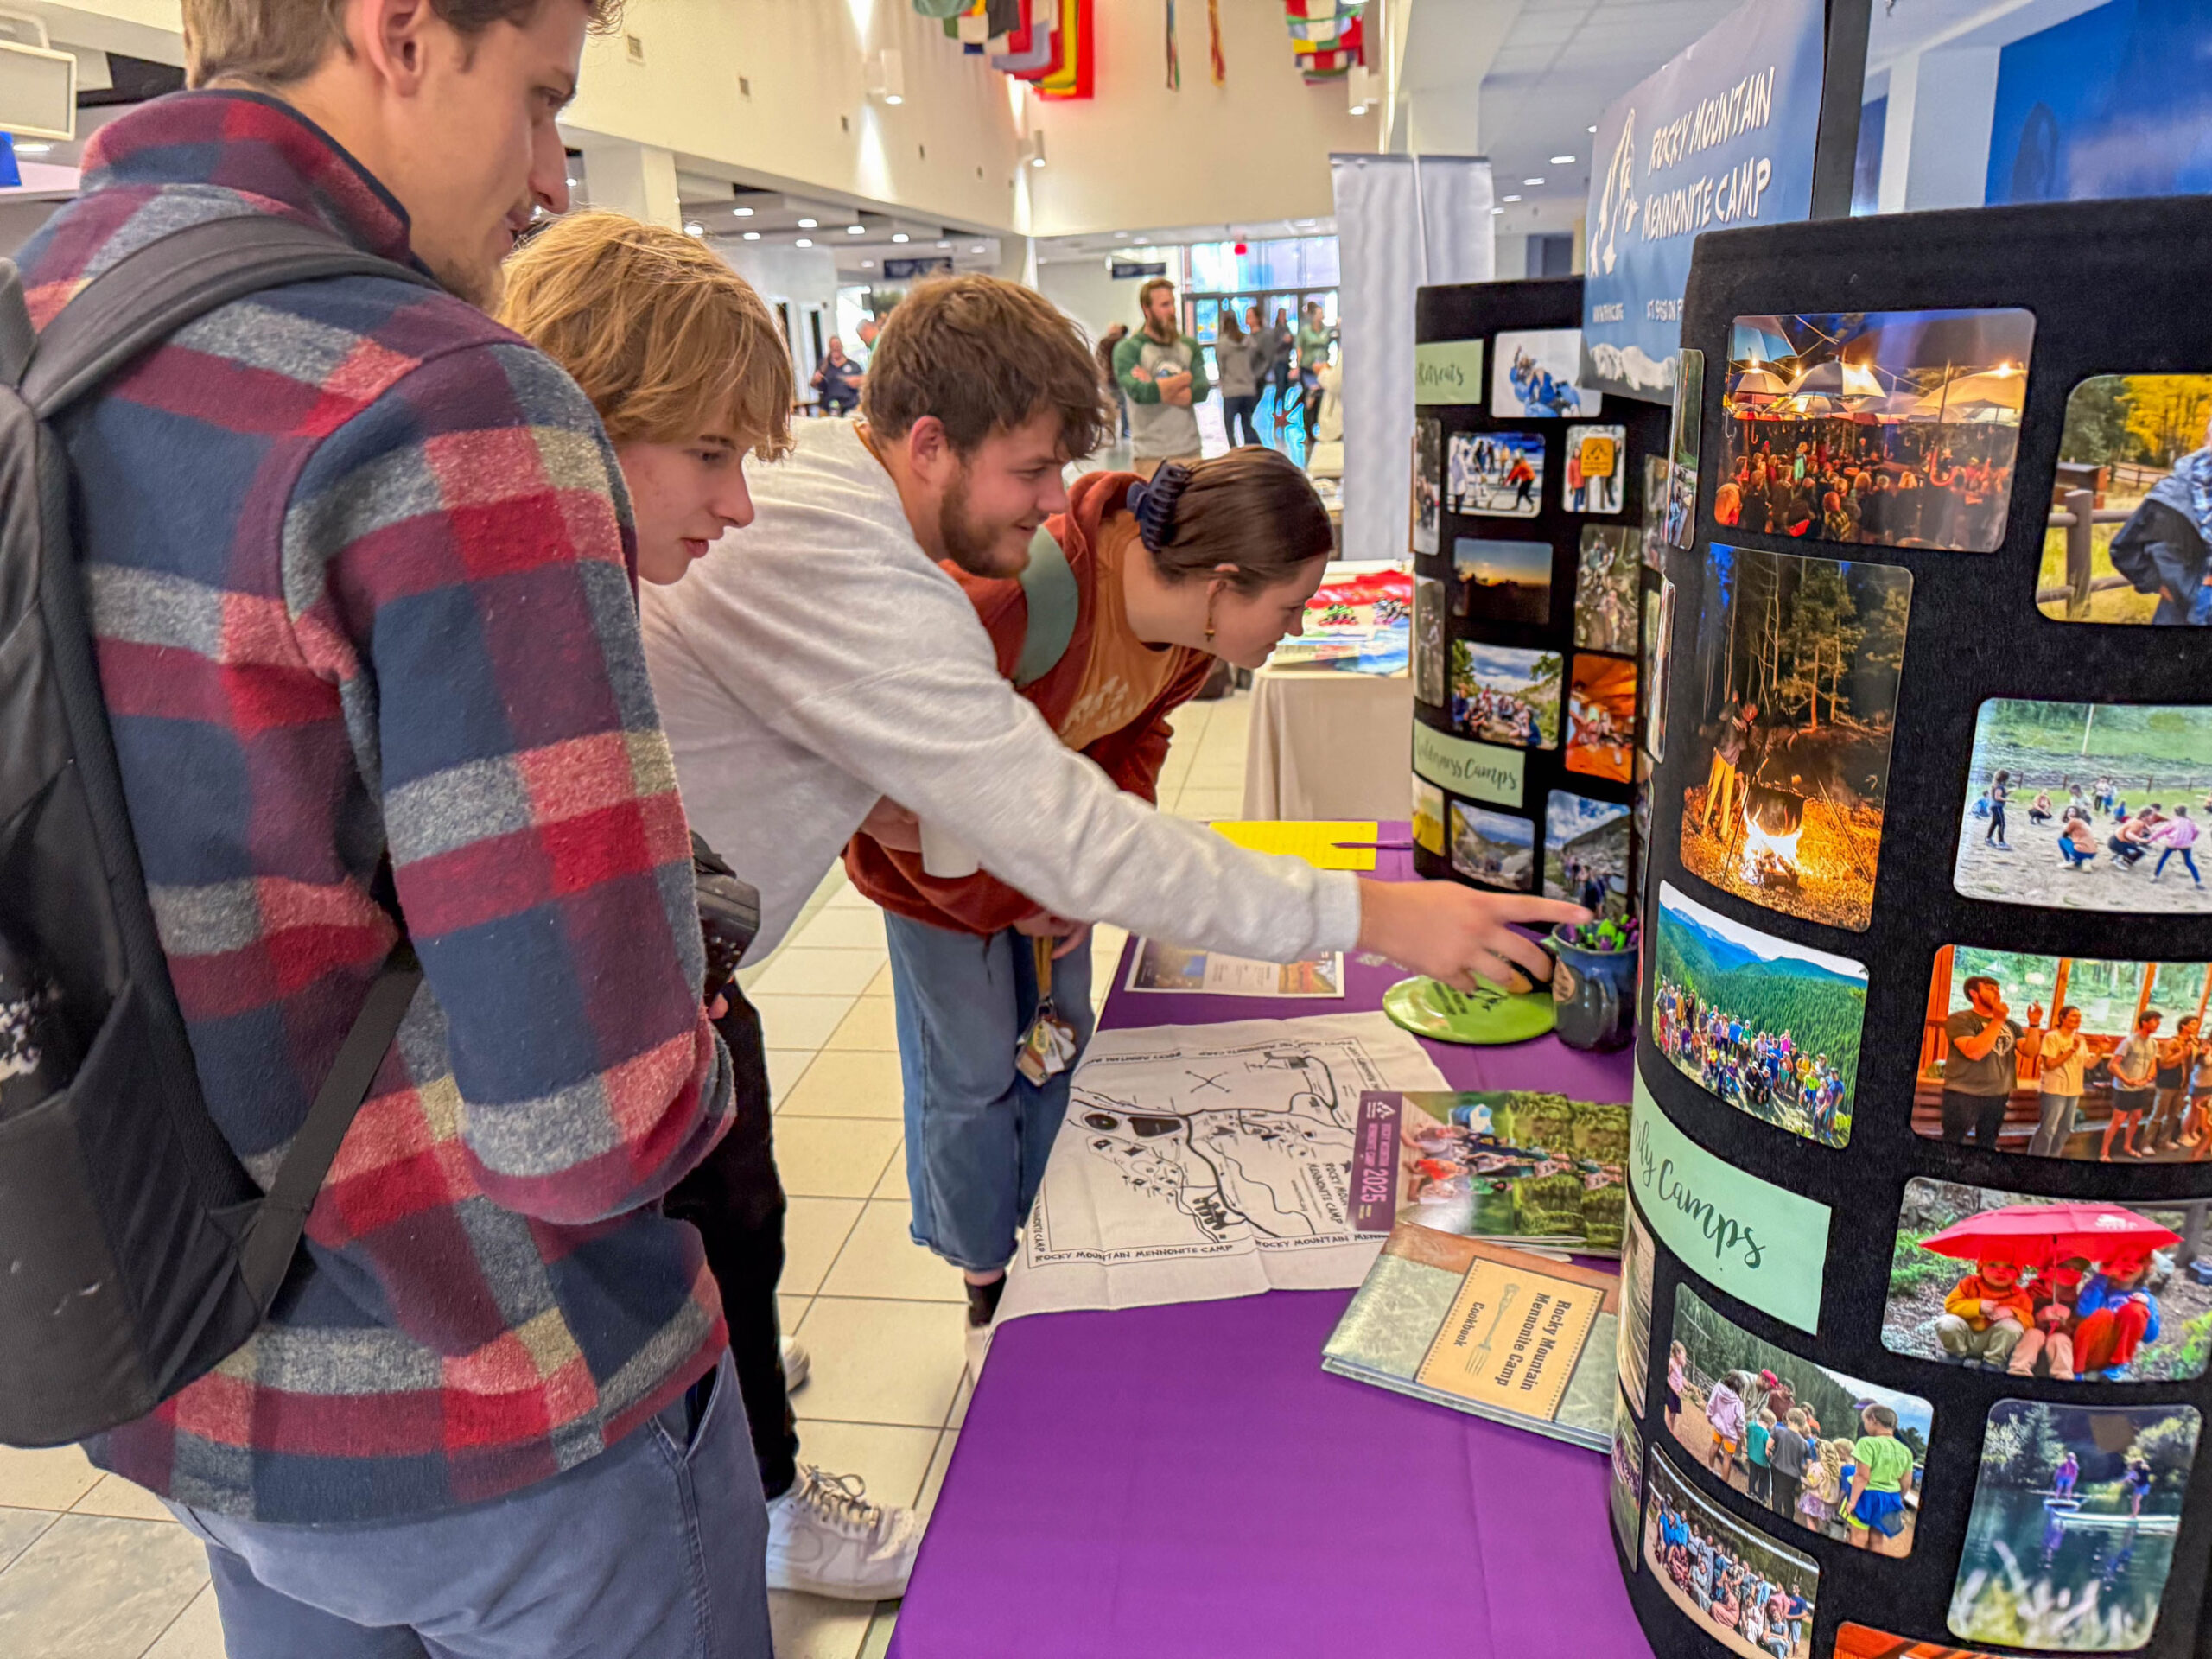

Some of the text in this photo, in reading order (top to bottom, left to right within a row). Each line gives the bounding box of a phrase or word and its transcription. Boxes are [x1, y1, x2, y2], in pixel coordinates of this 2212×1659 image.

[1647, 66, 1775, 176] ROCKY MOUNTAIN
[1641, 156, 1772, 242] MENNONITE CAMP
[1464, 757, 1517, 791] Camps
[1360, 1168, 1389, 1203] 2025
[1325, 1202, 1344, 1225] CAMP
[1657, 1158, 1767, 1269] Camps
[1035, 1244, 1234, 1262] ROCKY MOUNTAIN MENNONITE CAMP
[1254, 1239, 1290, 1248] ROCKY
[1294, 1236, 1350, 1247] MOUNTAIN
[1453, 1300, 1486, 1348] Cookbook
[1494, 1292, 1552, 1388] Mennonite Camp
[1519, 1300, 1573, 1392] Rocky Mountain
